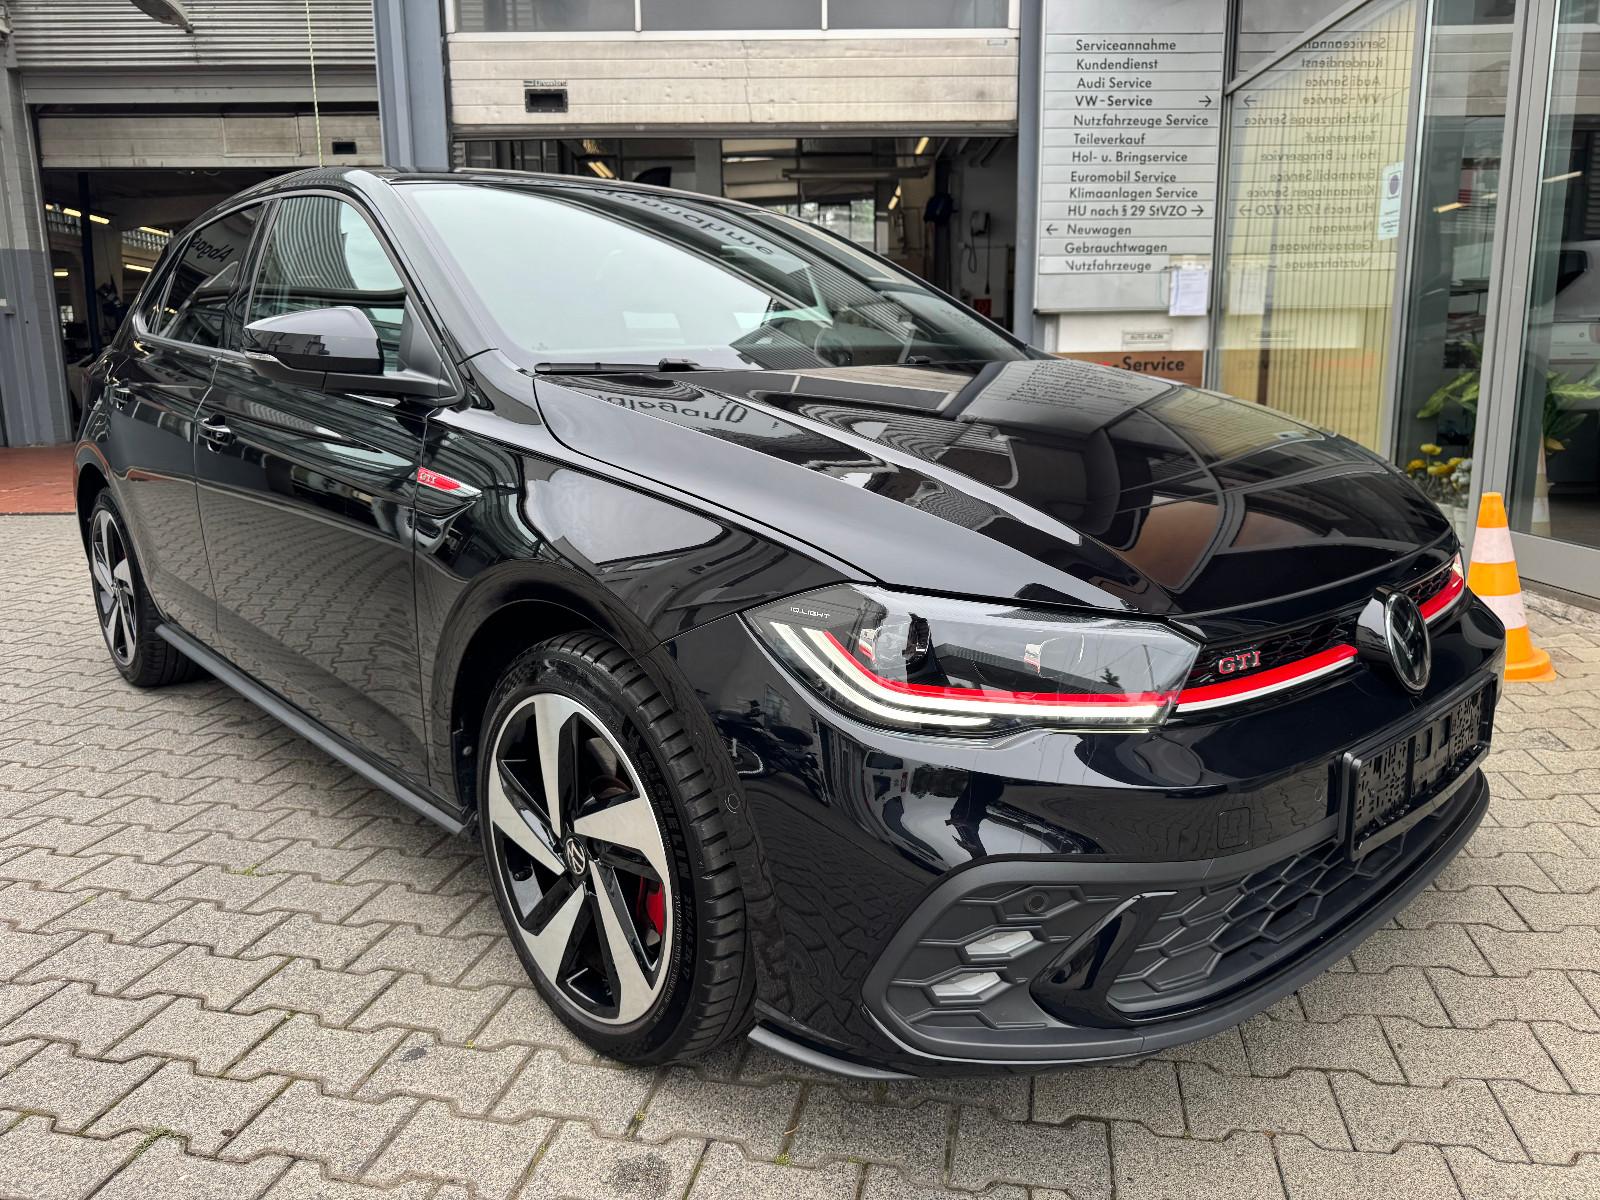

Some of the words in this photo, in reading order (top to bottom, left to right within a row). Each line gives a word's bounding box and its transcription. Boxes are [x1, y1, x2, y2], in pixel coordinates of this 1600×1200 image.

[1076, 39, 1177, 51] Serviceannahme
[1076, 58, 1158, 70] Kundendienst
[1077, 76, 1106, 89] Audi
[1109, 77, 1153, 89] Service
[1073, 114, 1163, 128] Nutzfahrzeuge
[1166, 114, 1209, 126] Service
[1073, 132, 1147, 145] Teileverkauf
[1072, 151, 1098, 163] Hol-
[1101, 154, 1112, 162] u.
[1115, 151, 1188, 165] Bringservice
[1070, 170, 1131, 183] Euromobil
[1134, 171, 1177, 183] Service
[1069, 187, 1152, 201] Klimaanlagen
[1155, 187, 1198, 199] Service
[1068, 205, 1087, 217] HU
[1090, 205, 1119, 217] nach
[1130, 205, 1145, 217] 29
[1149, 205, 1188, 217] StVZO
[1067, 223, 1132, 237] Neuwagen
[1065, 242, 1168, 255] Gebrauchtwagen
[1218, 650, 1262, 675] GTI
